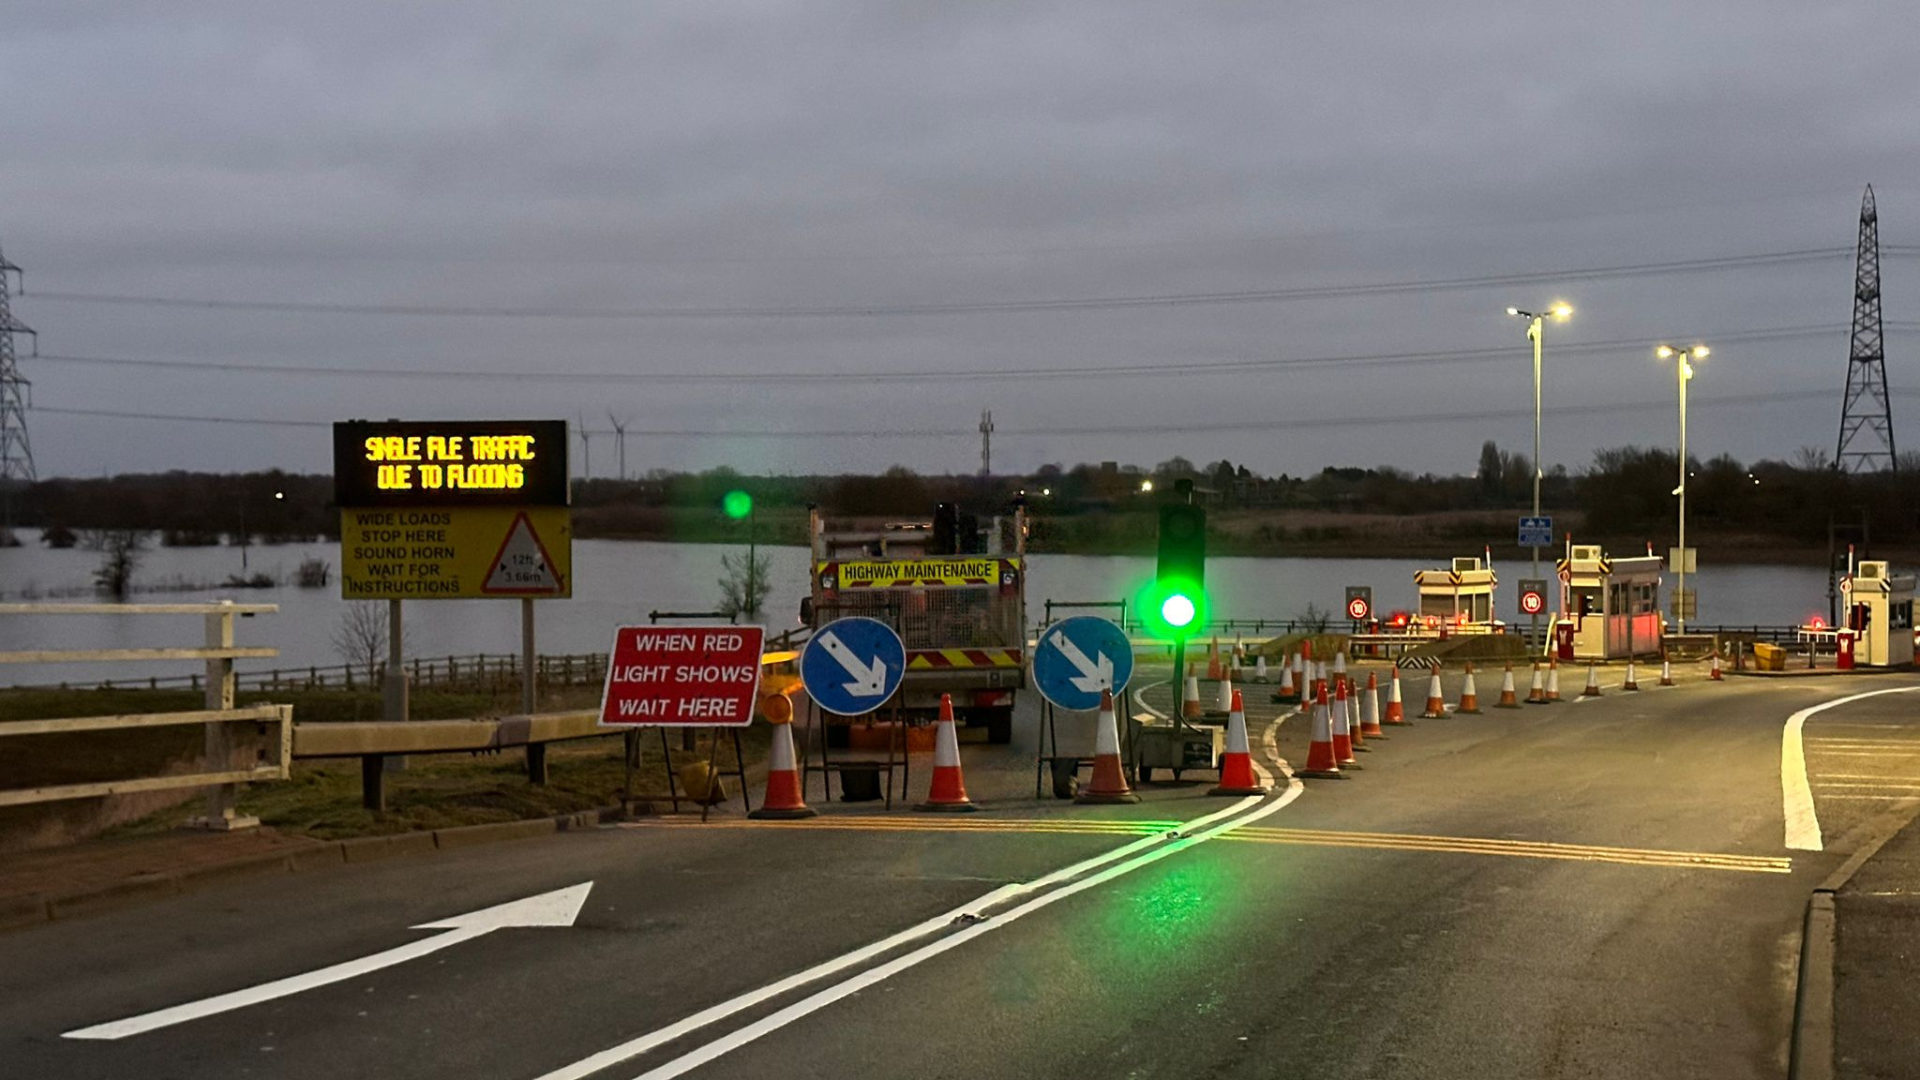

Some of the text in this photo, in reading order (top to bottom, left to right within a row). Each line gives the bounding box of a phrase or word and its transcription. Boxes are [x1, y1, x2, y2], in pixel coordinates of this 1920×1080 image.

[470, 435, 535, 460] TRAFFIC
[377, 464, 524, 489] DUE TO FLOODING
[356, 513, 451, 526] WIDE LOADS
[361, 530, 446, 542] STOP HERE
[354, 547, 455, 559] SOUND HORN
[512, 553, 534, 565] 12ft
[367, 564, 440, 576] WAIT FOR
[844, 562, 992, 579] HIGHWAY MAINTENANCE
[349, 580, 460, 593] INSTRUCTIONS
[1353, 603, 1364, 614] 10
[1526, 597, 1538, 608] 10
[636, 634, 743, 652] WHEN RED
[613, 665, 754, 683] LIGHT SHOWS
[619, 698, 739, 717] WAIT HERE
